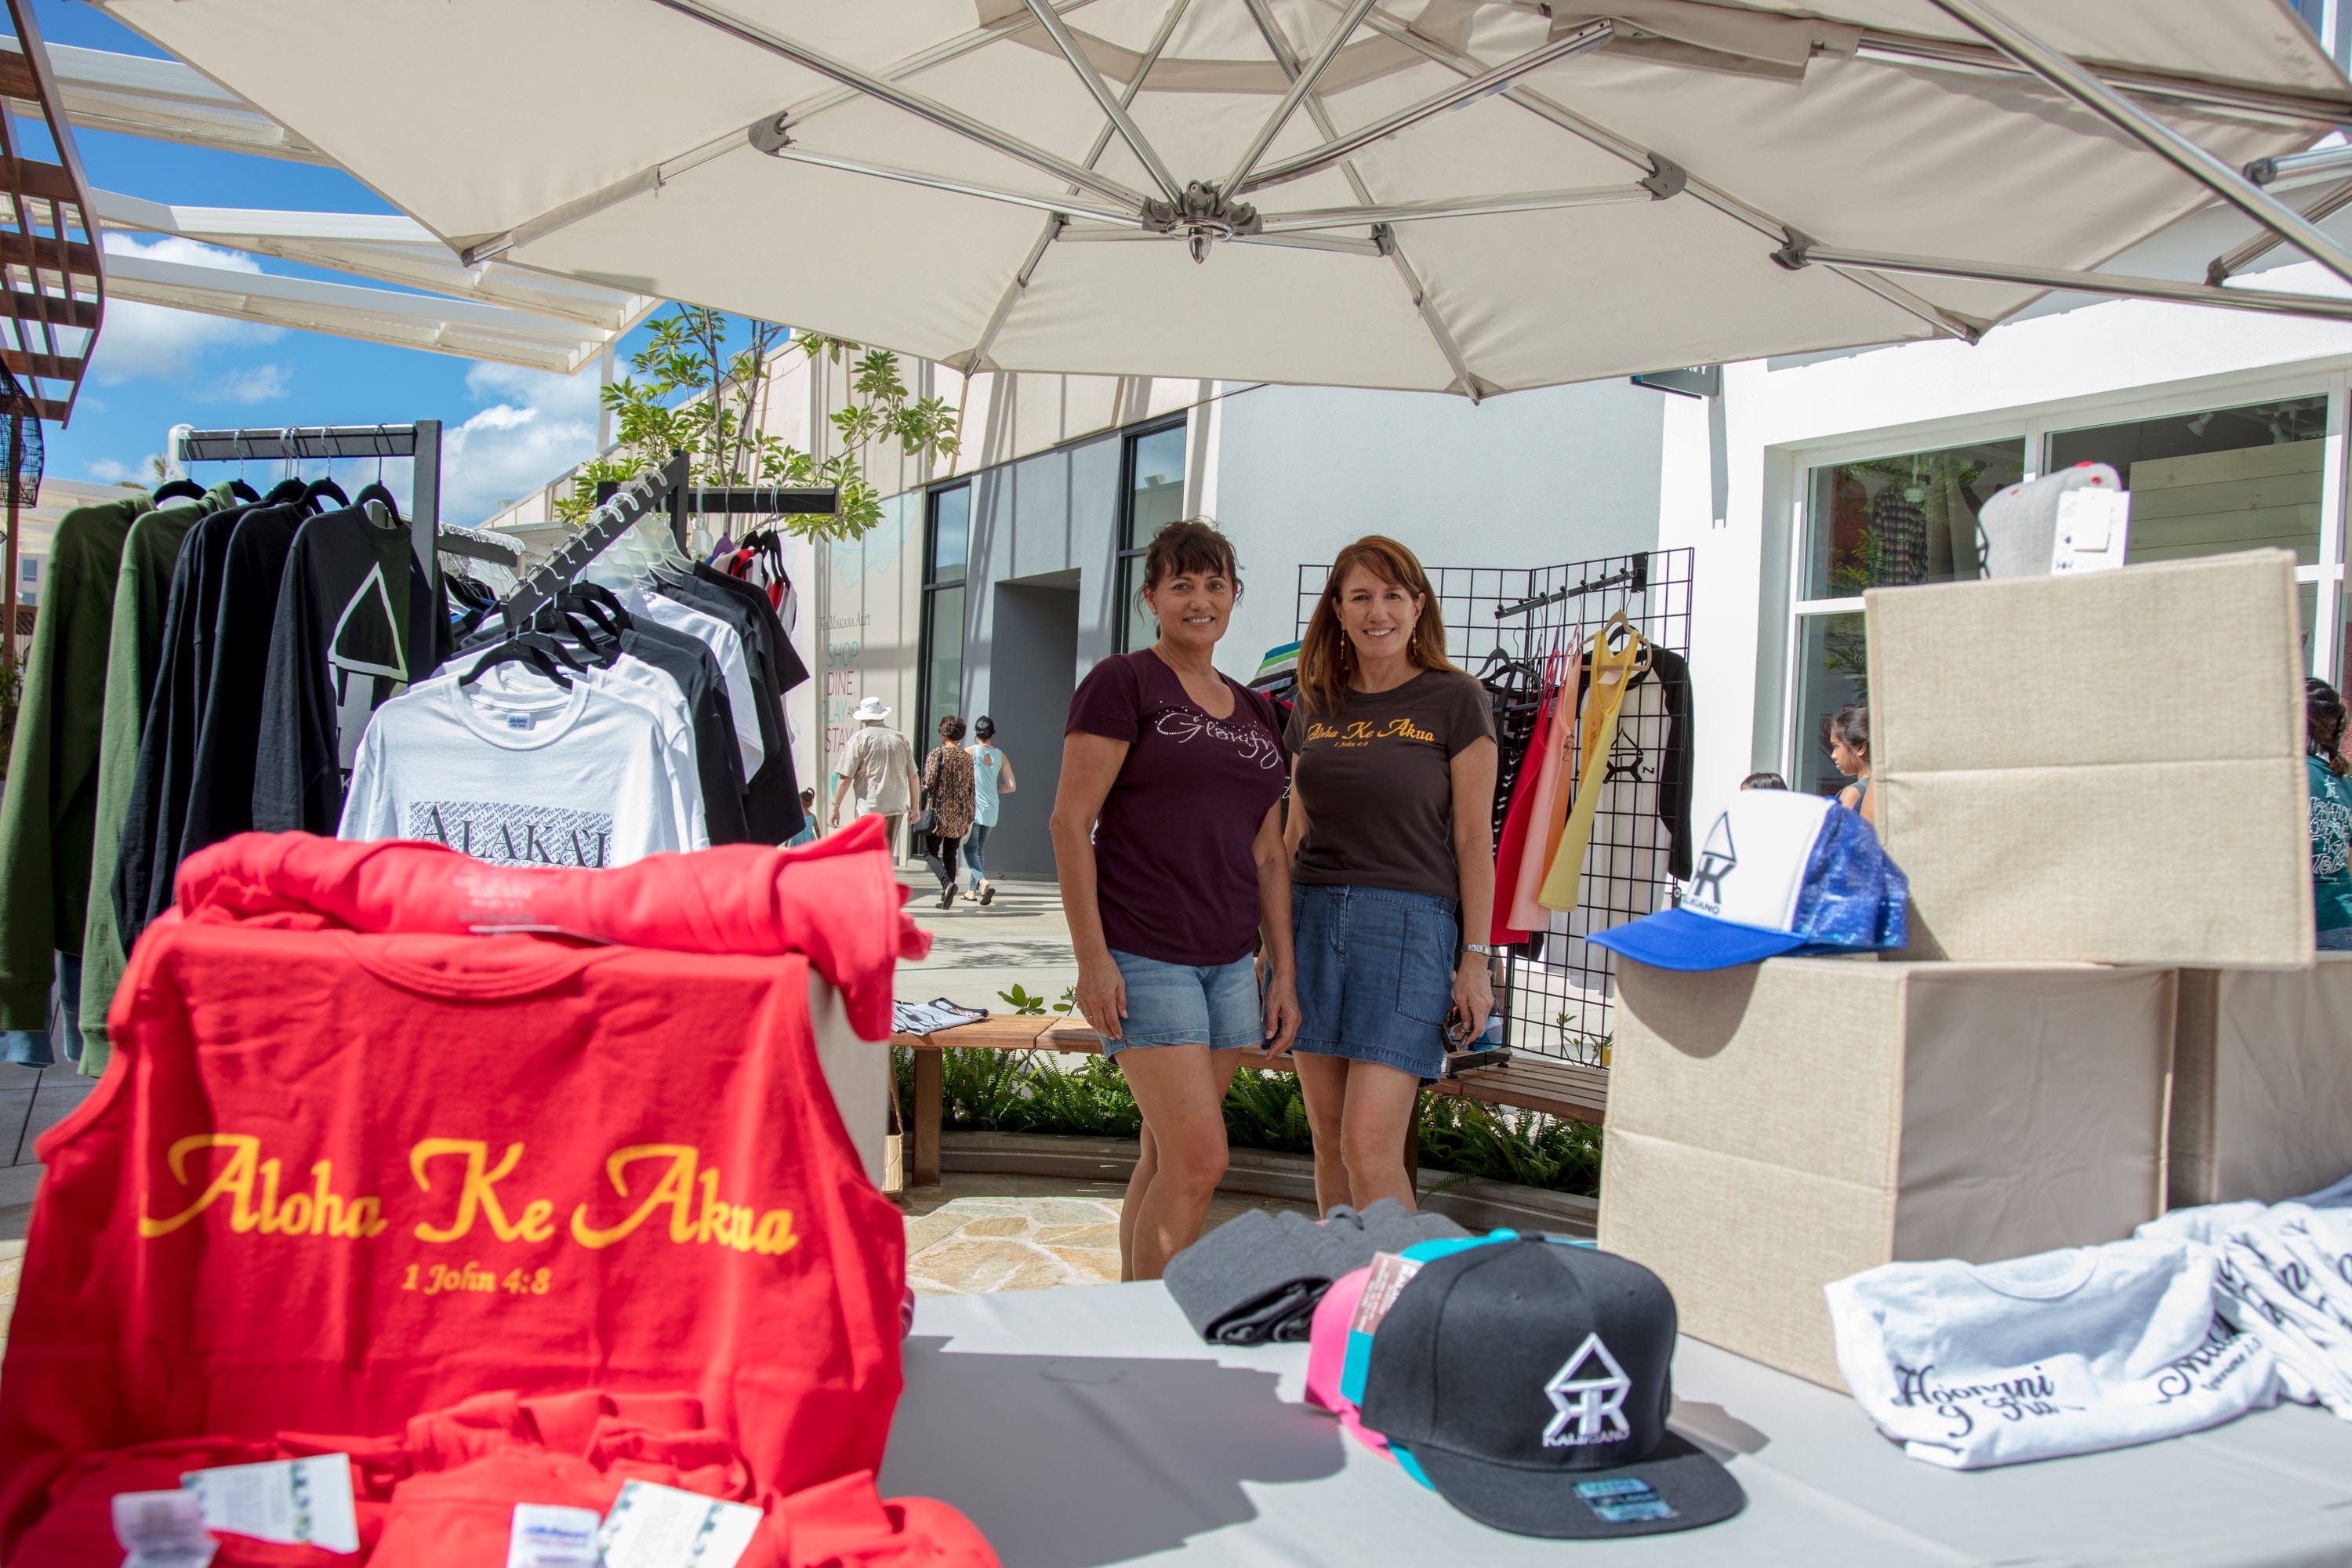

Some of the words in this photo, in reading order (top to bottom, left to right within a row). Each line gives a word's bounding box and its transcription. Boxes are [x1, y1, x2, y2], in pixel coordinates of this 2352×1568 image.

[821, 699, 848, 723] PLAY
[1341, 720, 1374, 739] Ke
[1377, 717, 1435, 742] Akua
[140, 1133, 390, 1239] Aloha
[409, 1137, 556, 1243] Ke
[570, 1143, 799, 1255] Akua
[401, 1264, 420, 1290] 1
[423, 1261, 496, 1295] John
[502, 1267, 552, 1295] 4:8
